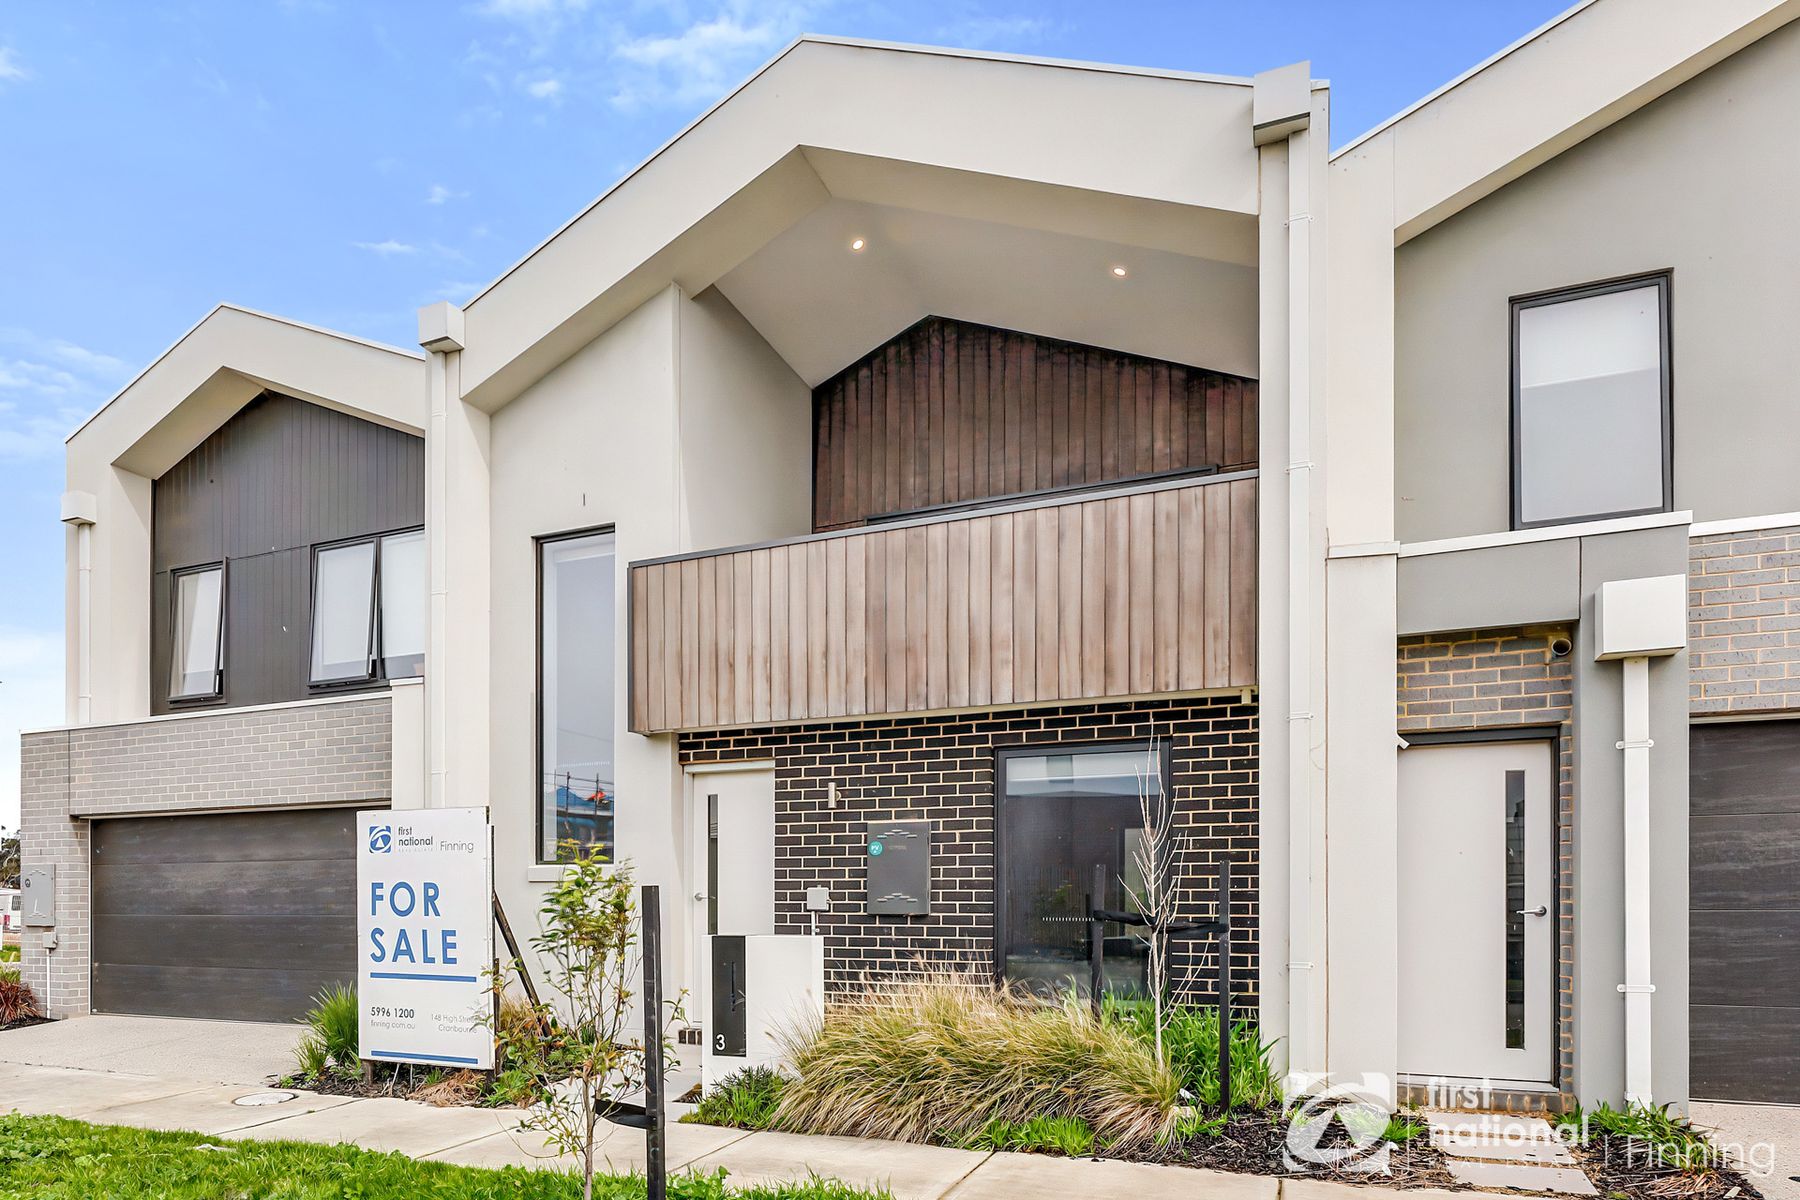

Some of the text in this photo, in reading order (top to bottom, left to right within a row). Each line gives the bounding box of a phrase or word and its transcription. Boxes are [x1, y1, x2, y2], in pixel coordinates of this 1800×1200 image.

[398, 826, 412, 836] first
[398, 836, 433, 847] national
[440, 841, 474, 853] Finning
[370, 881, 441, 917] FOR
[370, 927, 458, 965] SALE
[370, 1006, 415, 1019] 5996 1200
[715, 1033, 726, 1051] 3
